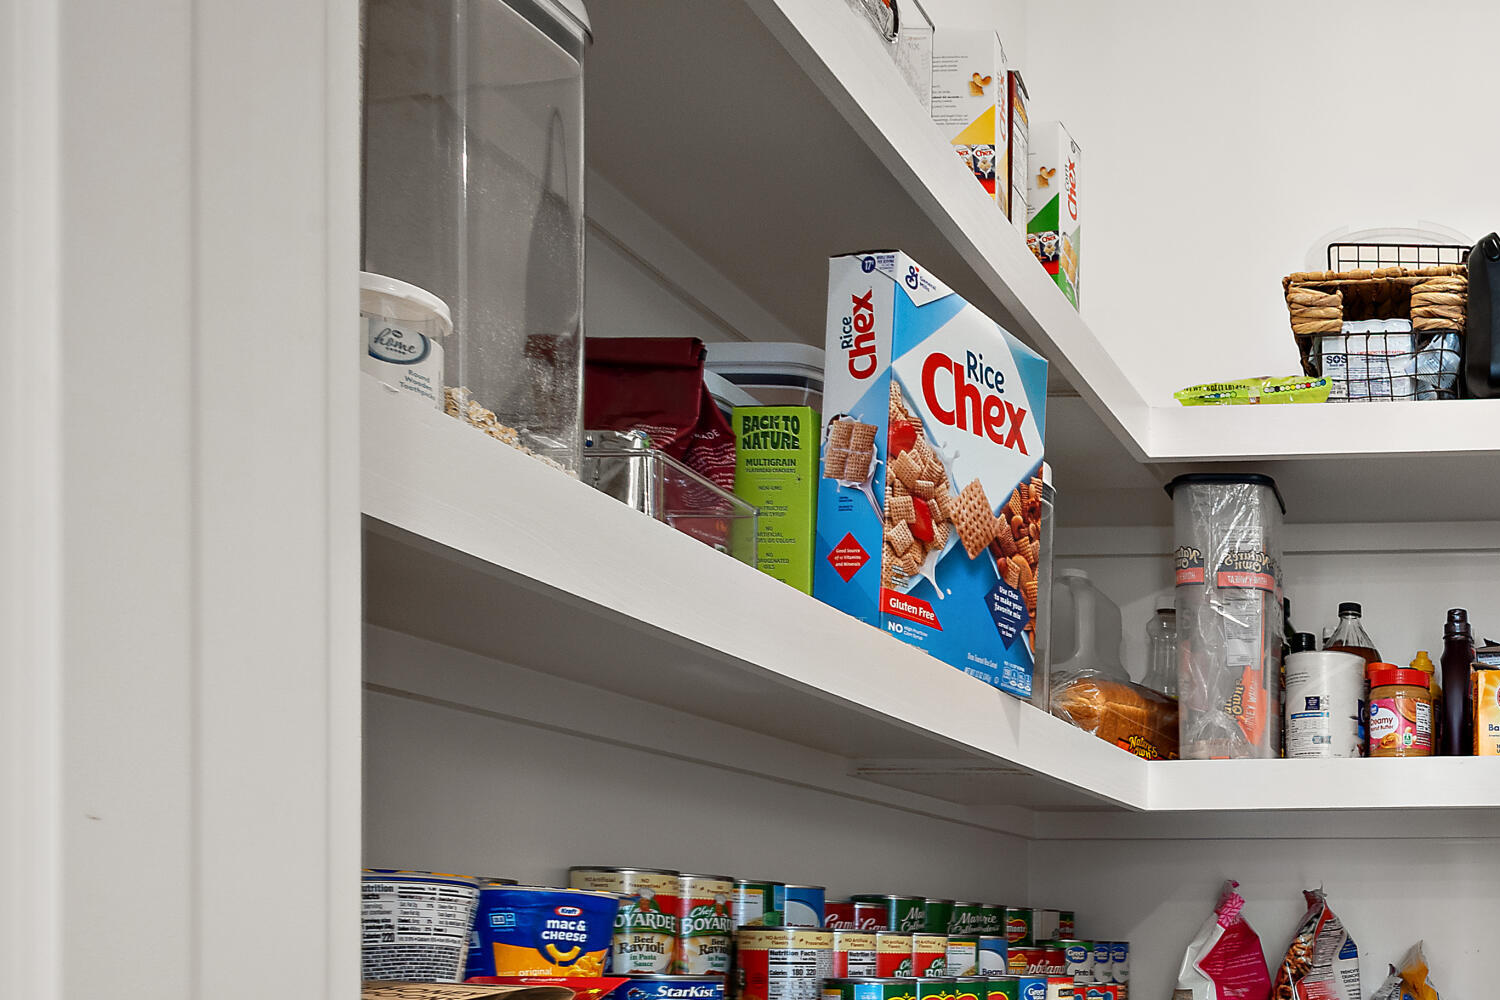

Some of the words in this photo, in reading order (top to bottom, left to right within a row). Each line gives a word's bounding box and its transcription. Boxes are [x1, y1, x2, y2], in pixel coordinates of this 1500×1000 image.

[841, 316, 852, 349] Rice
[848, 289, 877, 379] Chex
[967, 350, 1005, 393] Rice
[922, 353, 1028, 456] Chex
[742, 416, 779, 435] BACK
[783, 416, 800, 435] TO
[742, 431, 800, 450] NATURE
[746, 459, 796, 467] MULTIGRAIN
[889, 597, 918, 615] Gluten
[918, 607, 935, 621] Free
[888, 621, 904, 633] NO
[690, 907, 713, 918] Chef
[547, 920, 571, 930] mac
[571, 922, 587, 932] &
[634, 936, 654, 944] Beef
[618, 942, 665, 955] Ravioli
[518, 967, 552, 977] original
[792, 968, 804, 976] 180
[805, 968, 817, 976] 320
[656, 985, 714, 998] StarKist
[1028, 987, 1045, 996] Great
